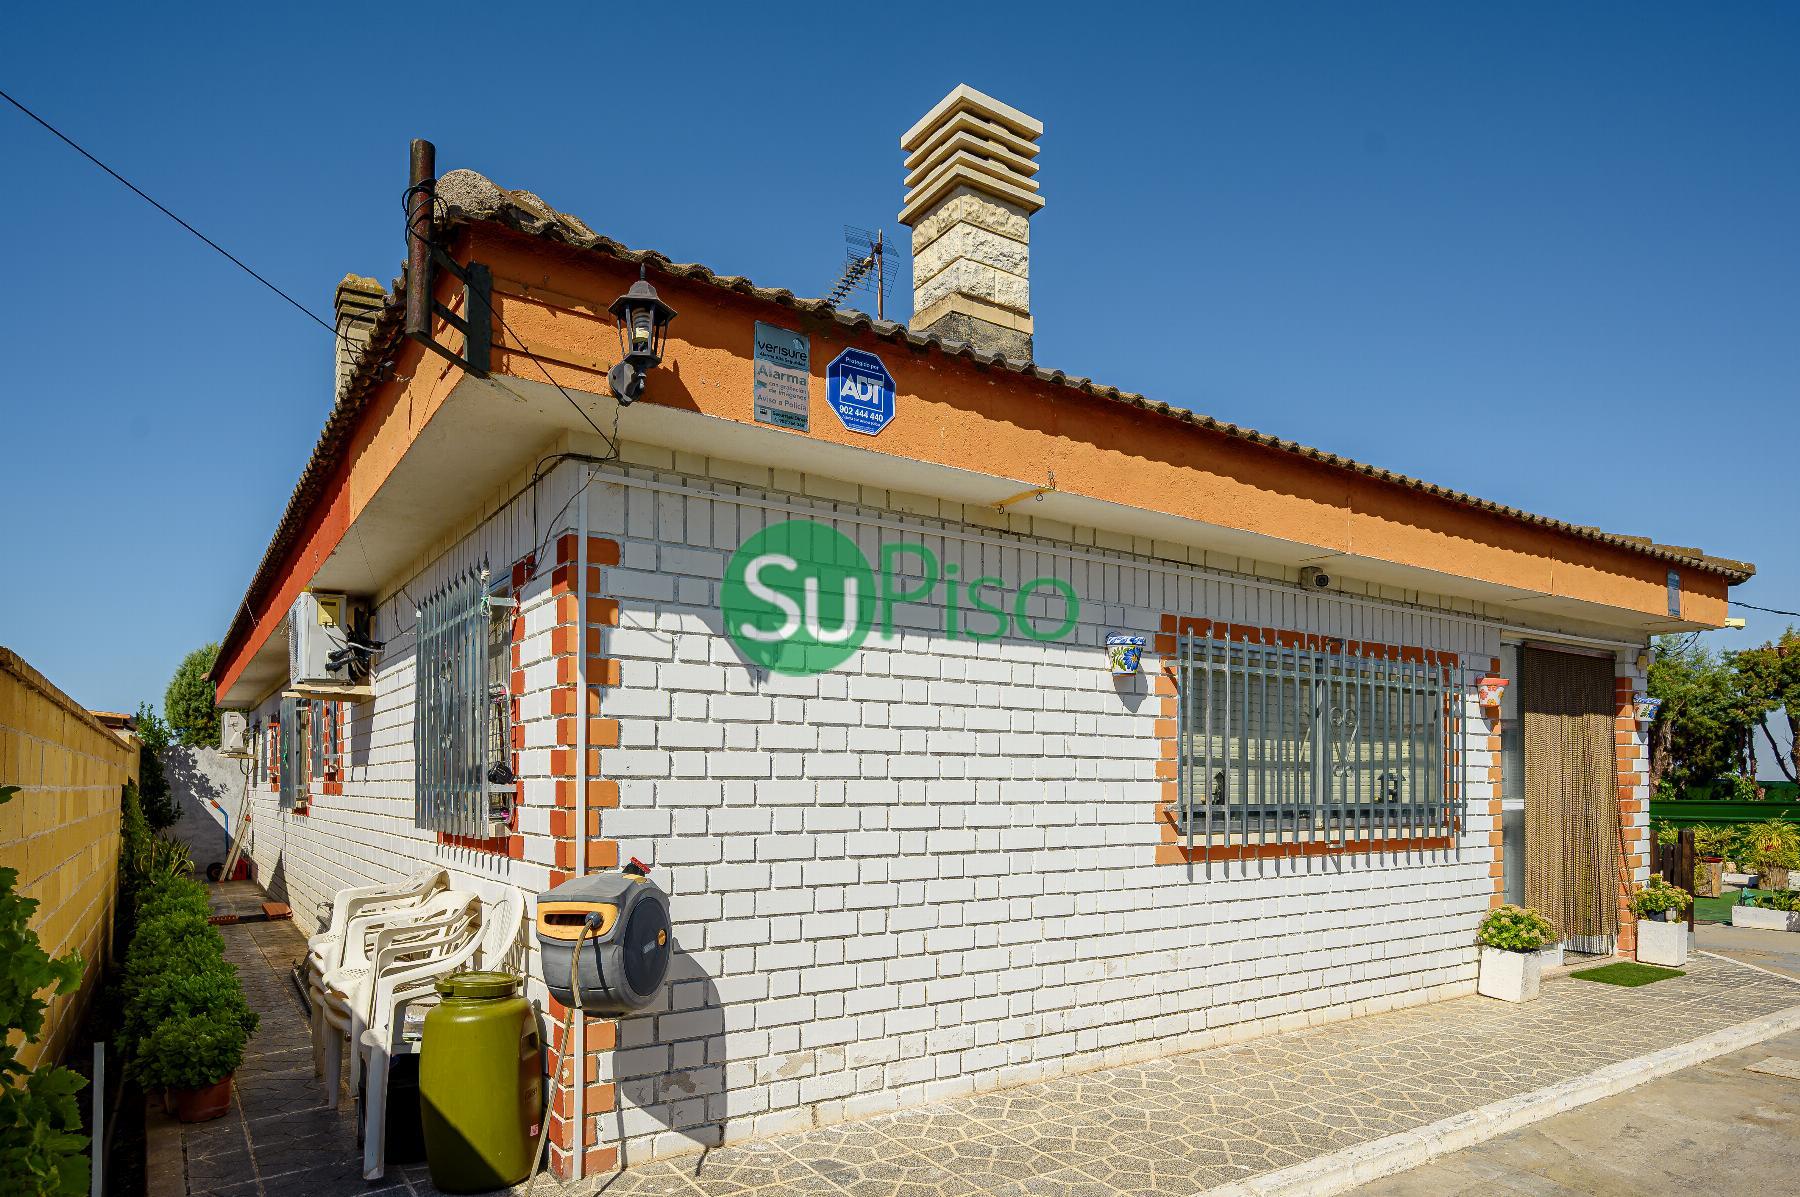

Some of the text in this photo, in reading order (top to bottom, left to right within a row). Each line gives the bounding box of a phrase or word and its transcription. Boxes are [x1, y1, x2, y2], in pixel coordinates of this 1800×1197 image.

[758, 341, 807, 361] verisure
[757, 364, 807, 386] Alarma
[841, 373, 884, 404] ADT
[840, 405, 853, 415] 902
[854, 408, 868, 418] 444
[870, 412, 884, 422] 440
